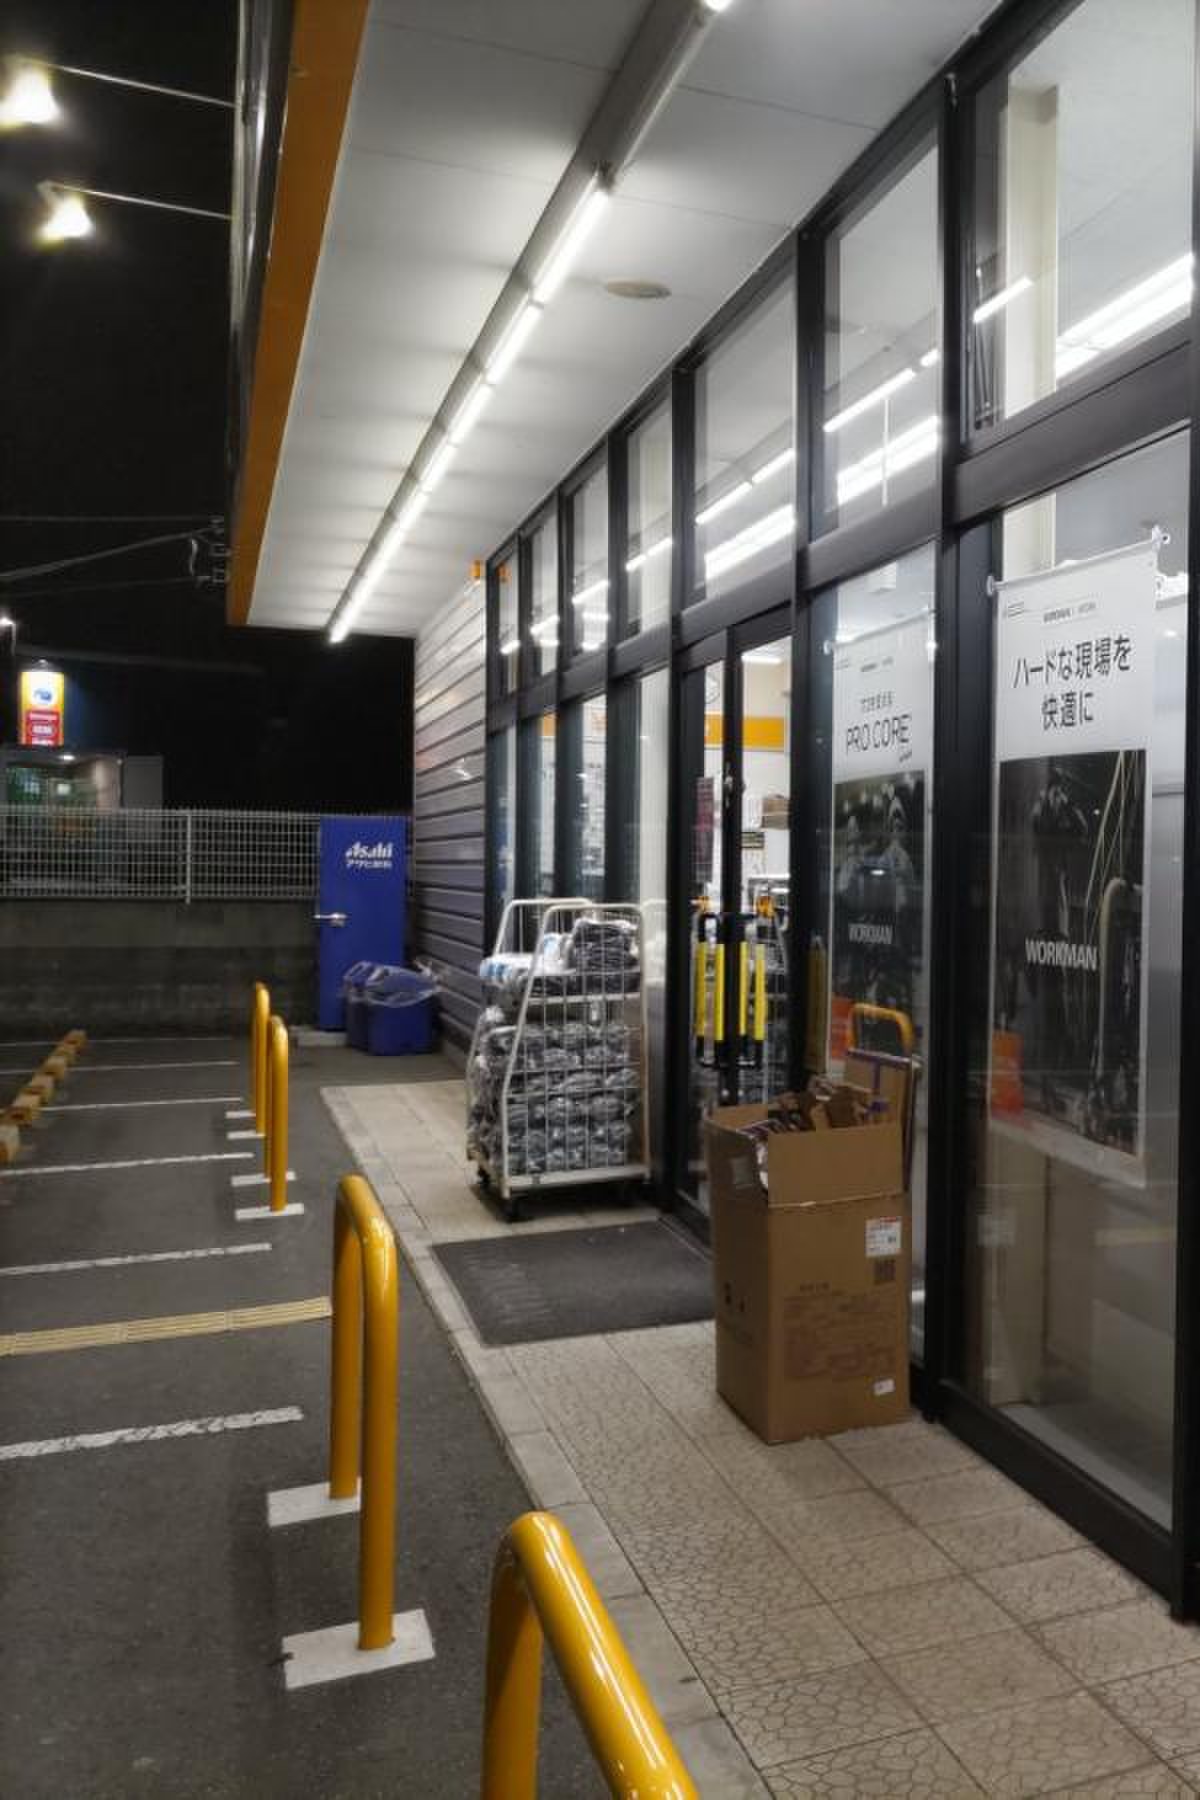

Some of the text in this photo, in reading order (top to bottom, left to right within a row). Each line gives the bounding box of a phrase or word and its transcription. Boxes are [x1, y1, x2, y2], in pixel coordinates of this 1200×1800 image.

[1013, 634, 1131, 688] ハードな現場を
[1042, 690, 1094, 731] 快適に
[845, 712, 911, 757] PRO CORE
[345, 841, 394, 859] Asahi
[1025, 937, 1099, 972] WORKMAN
